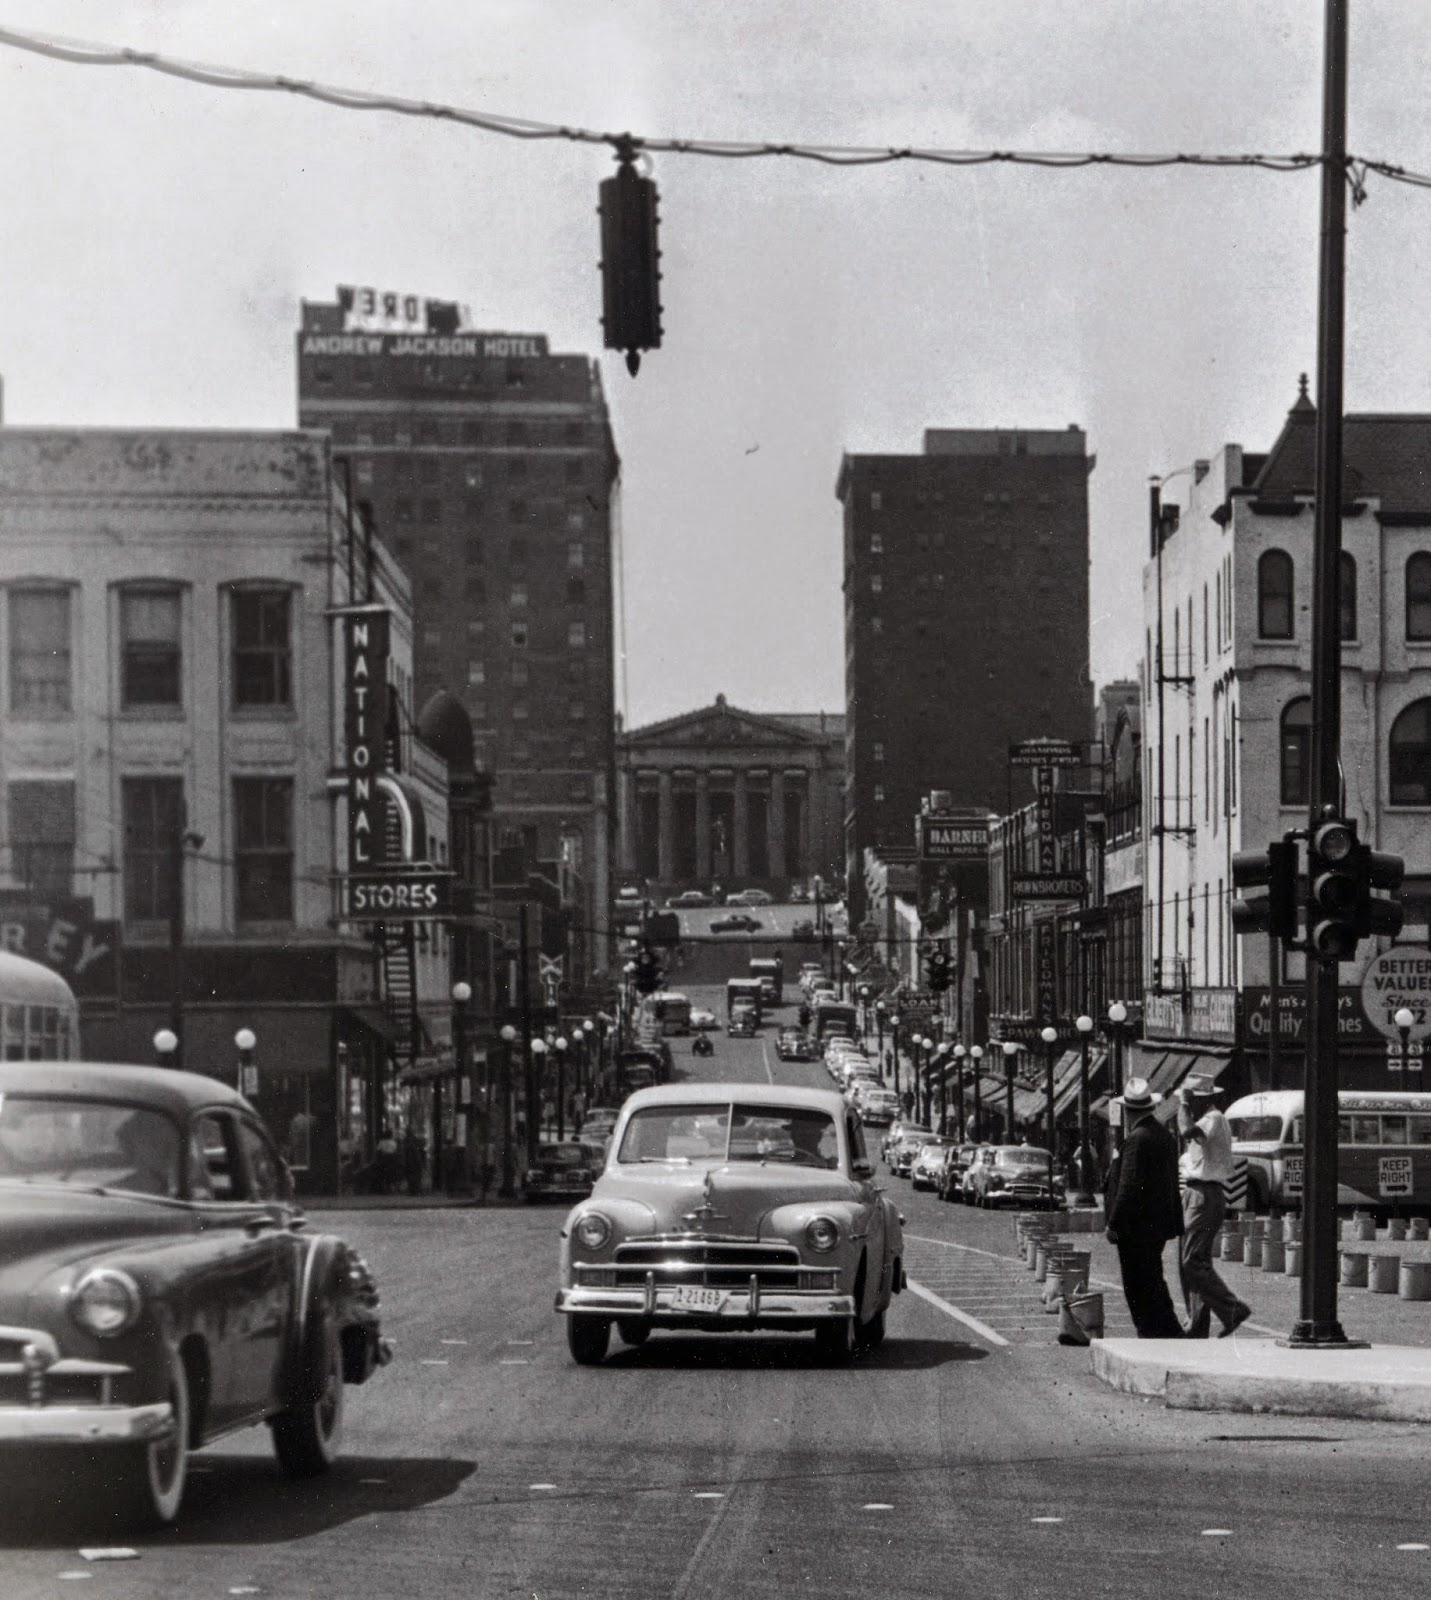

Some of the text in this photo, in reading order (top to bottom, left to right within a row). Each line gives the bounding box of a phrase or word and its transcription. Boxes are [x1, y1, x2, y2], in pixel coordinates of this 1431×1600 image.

[303, 336, 540, 356] ANDREW JACKSON HOTEL
[353, 624, 370, 862] NATIONAL
[355, 883, 438, 908] STORES
[1250, 1012, 1303, 1037] Qulity
[1382, 1160, 1409, 1171] KEEP
[1381, 1172, 1412, 1183] RIGHT
